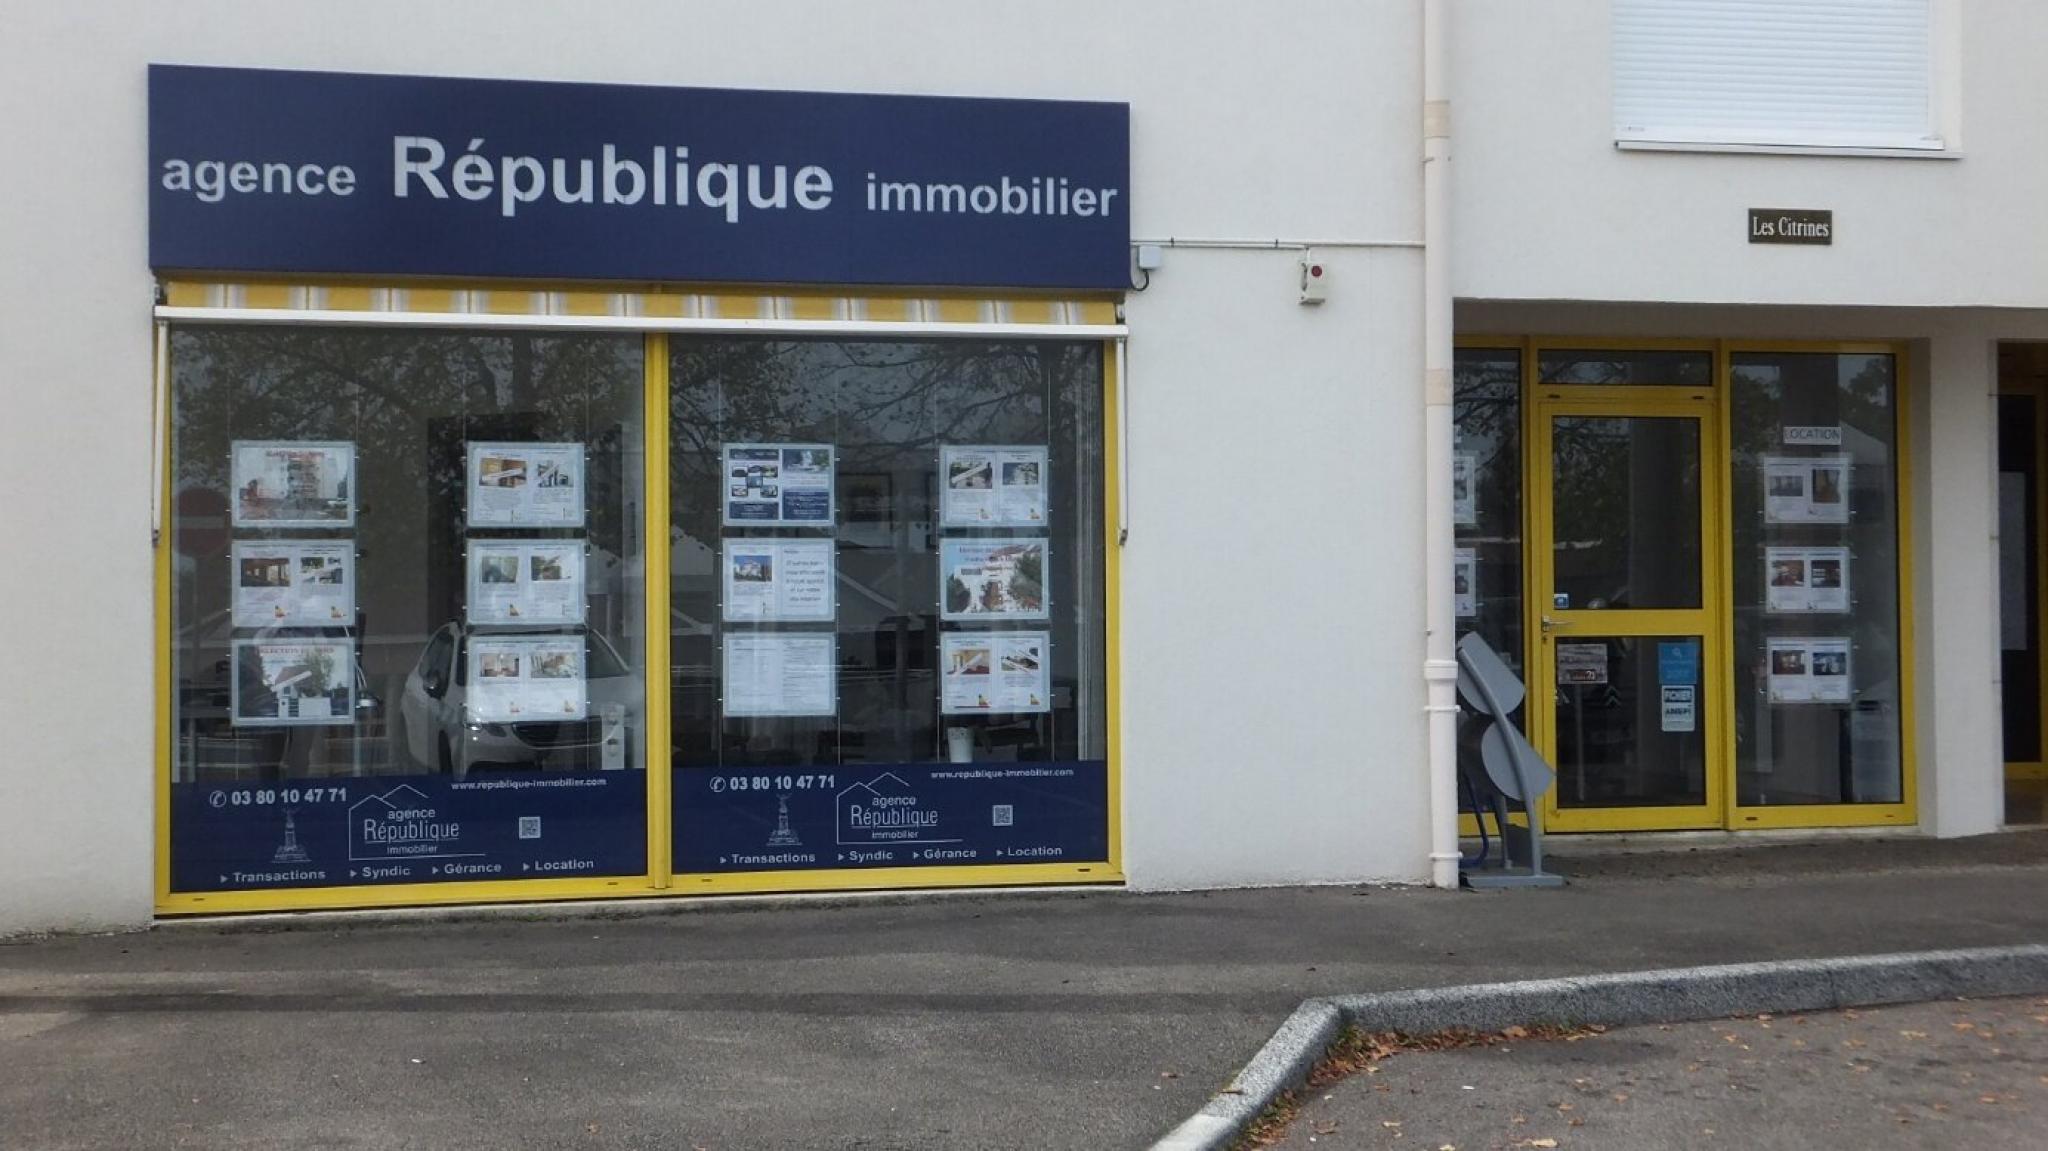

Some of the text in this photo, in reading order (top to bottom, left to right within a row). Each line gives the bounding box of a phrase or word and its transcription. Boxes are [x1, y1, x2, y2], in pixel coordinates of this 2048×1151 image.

[162, 136, 1117, 223] agence République immobilier
[1753, 216, 1830, 237] Les Citrines
[931, 768, 1074, 780] www.republique-immobilier.com
[451, 778, 607, 790] www.republique-immobilier.com
[730, 775, 835, 790] 03 80 10 47 71
[231, 787, 347, 805] 03 80 10 47 71
[872, 795, 916, 809] agence
[388, 808, 436, 822] agence
[850, 804, 938, 828] République
[364, 818, 460, 842] République
[872, 830, 918, 839] immobilier
[387, 844, 438, 855] immobilier
[731, 846, 1063, 864] Transactions Syndic Gérance Location
[233, 858, 594, 883] Transactions Syndic Gérance Location
